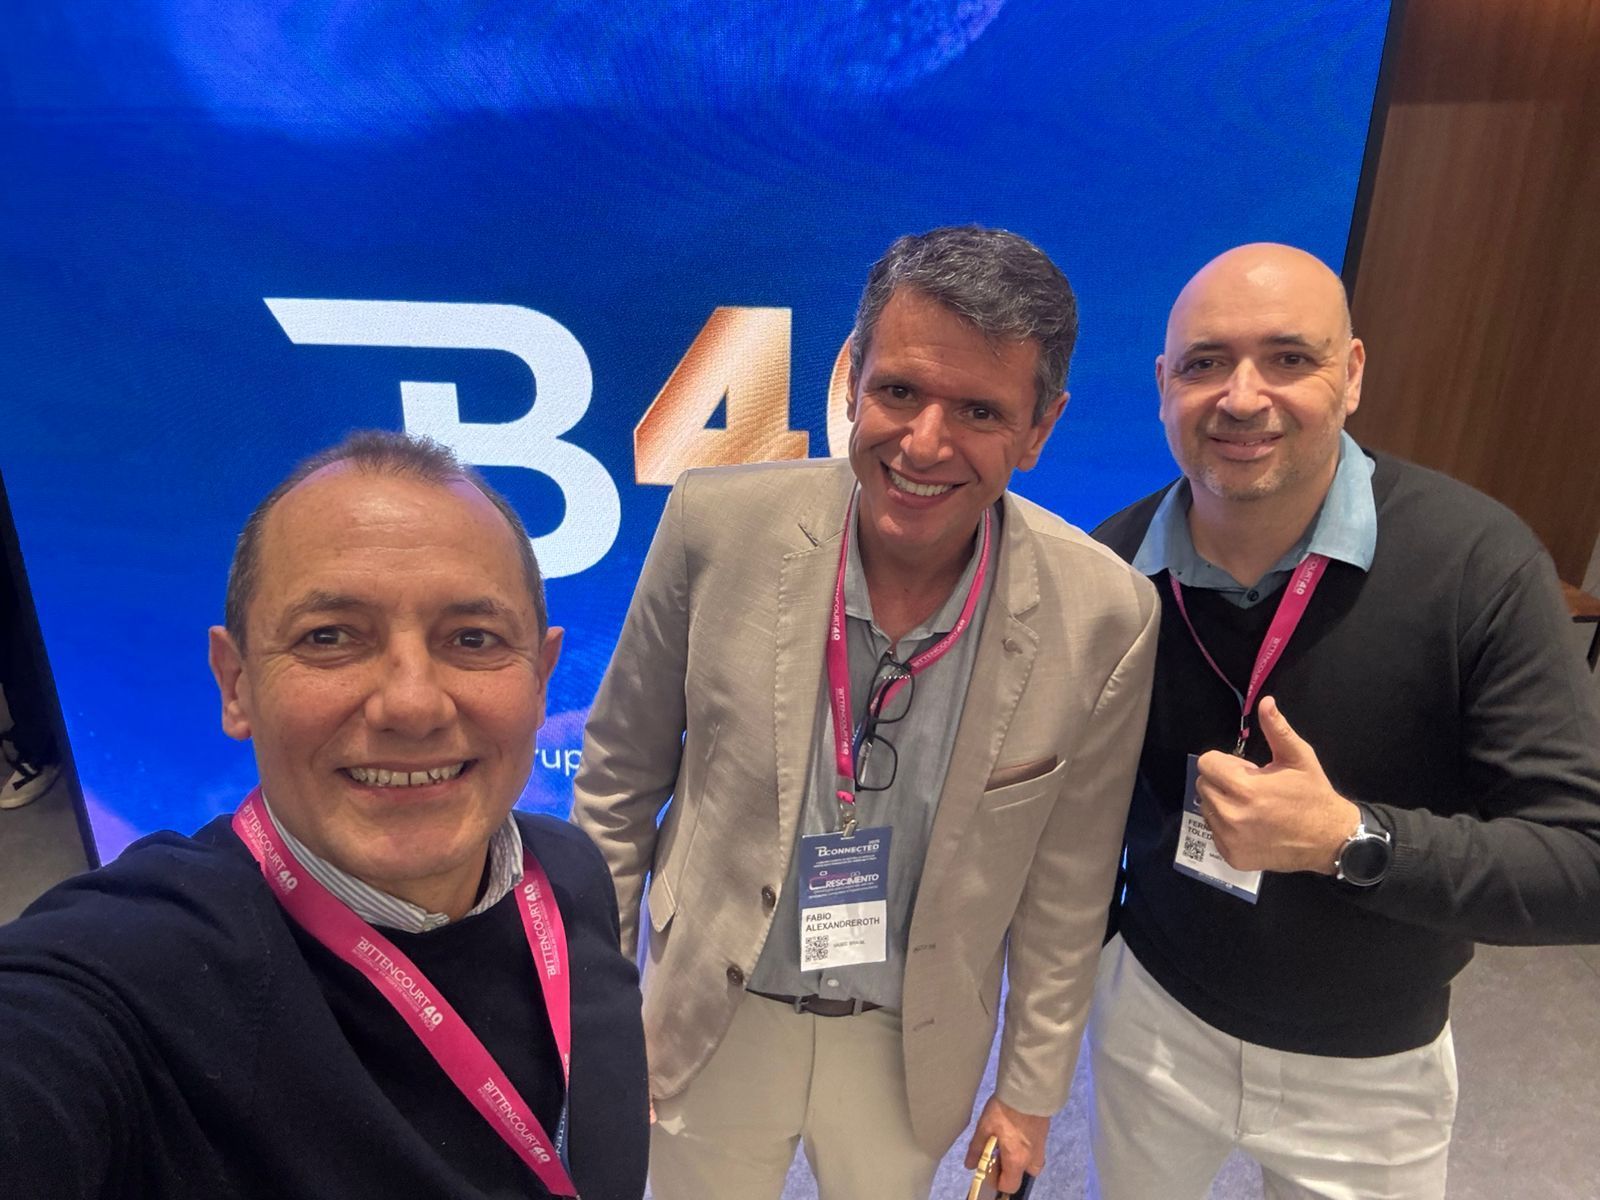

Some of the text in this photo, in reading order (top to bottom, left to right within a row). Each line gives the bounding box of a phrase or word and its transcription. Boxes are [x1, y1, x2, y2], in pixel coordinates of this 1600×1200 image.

[535, 748, 582, 777] up
[1188, 819, 1212, 832] FERN
[1188, 827, 1214, 840] TOLED
[806, 912, 832, 922] FABIO
[806, 917, 880, 932] ALEXANDREROTH
